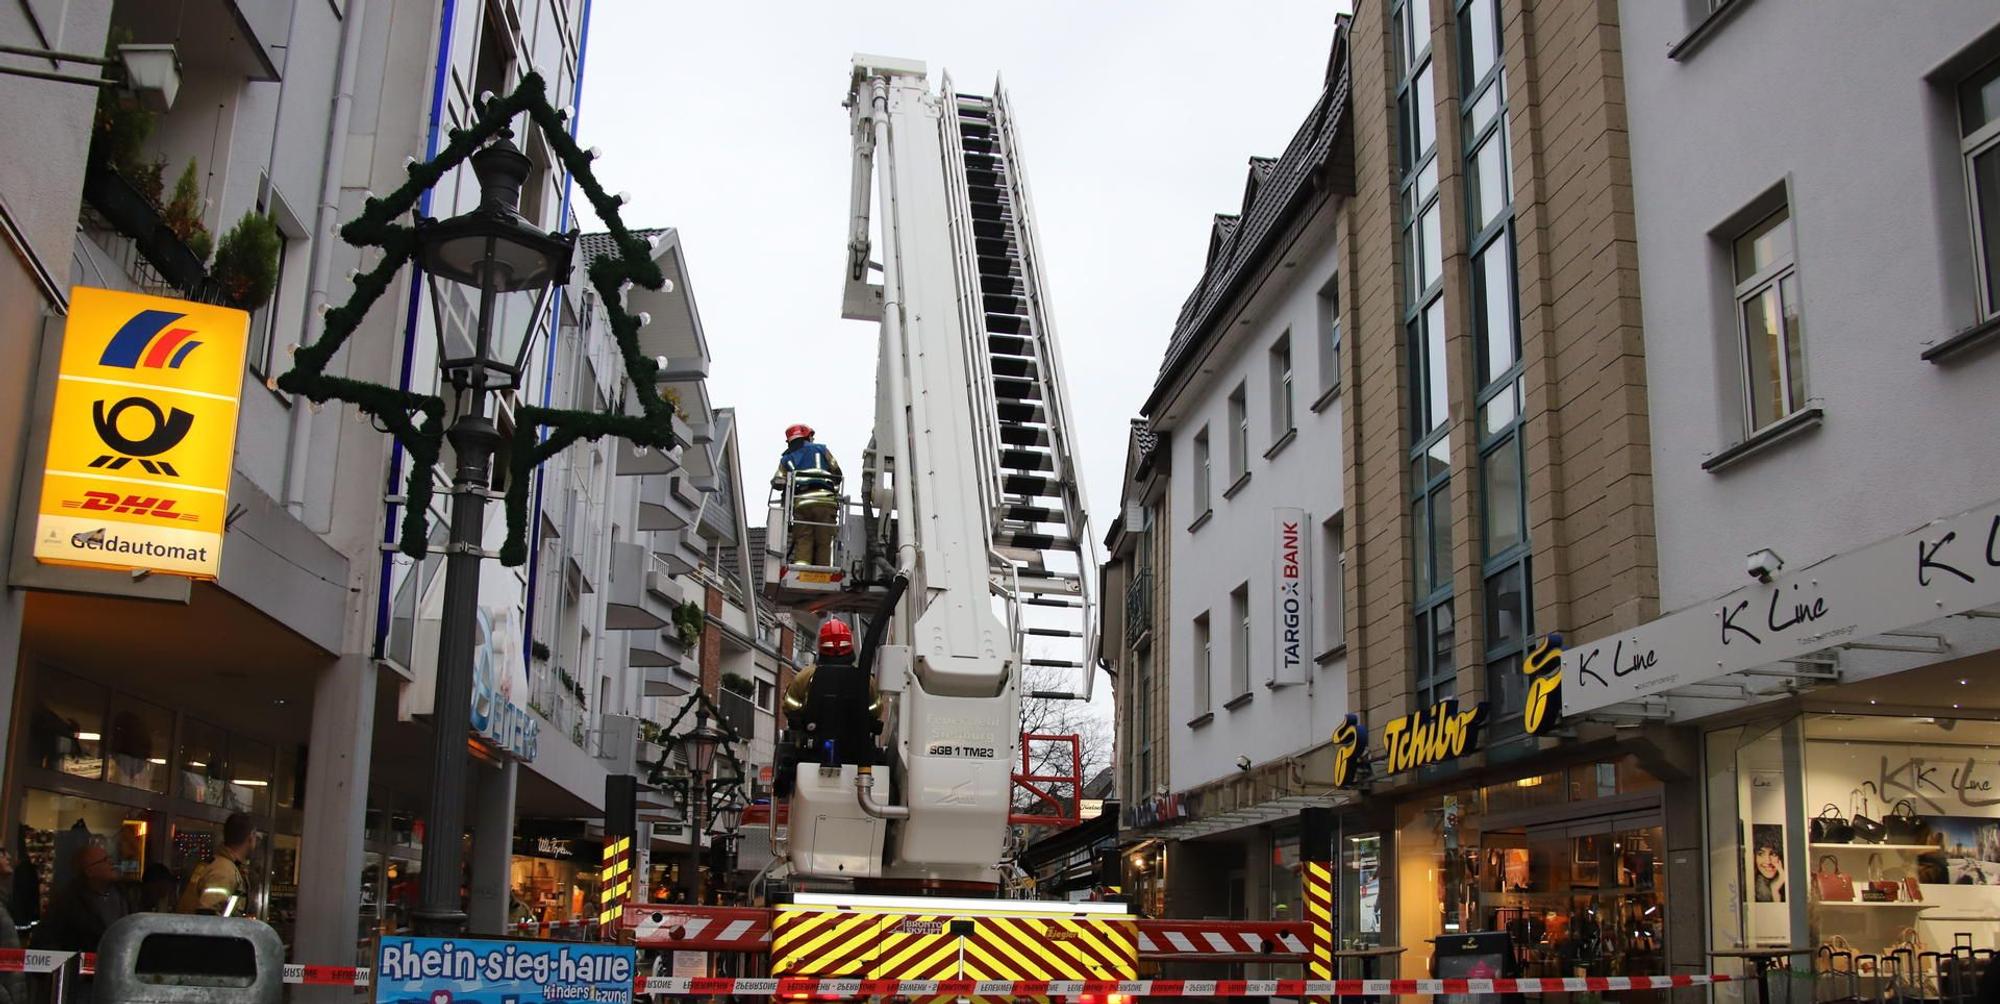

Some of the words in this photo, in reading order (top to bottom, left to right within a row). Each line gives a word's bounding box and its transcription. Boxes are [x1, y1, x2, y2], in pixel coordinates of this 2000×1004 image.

[80, 490, 182, 520] DHL
[1283, 522, 1298, 579] BANK
[1918, 531, 1975, 586] K
[1284, 598, 1299, 669] TARGO
[1722, 600, 1761, 645] K
[1768, 584, 1829, 632] Line
[1579, 649, 1609, 687] K
[1613, 640, 1658, 677] Line
[930, 745, 953, 756] SGB
[955, 746, 961, 756] 1
[963, 747, 994, 758] TM23
[1383, 701, 1478, 775] Tchibo
[906, 920, 942, 928] BRONTO
